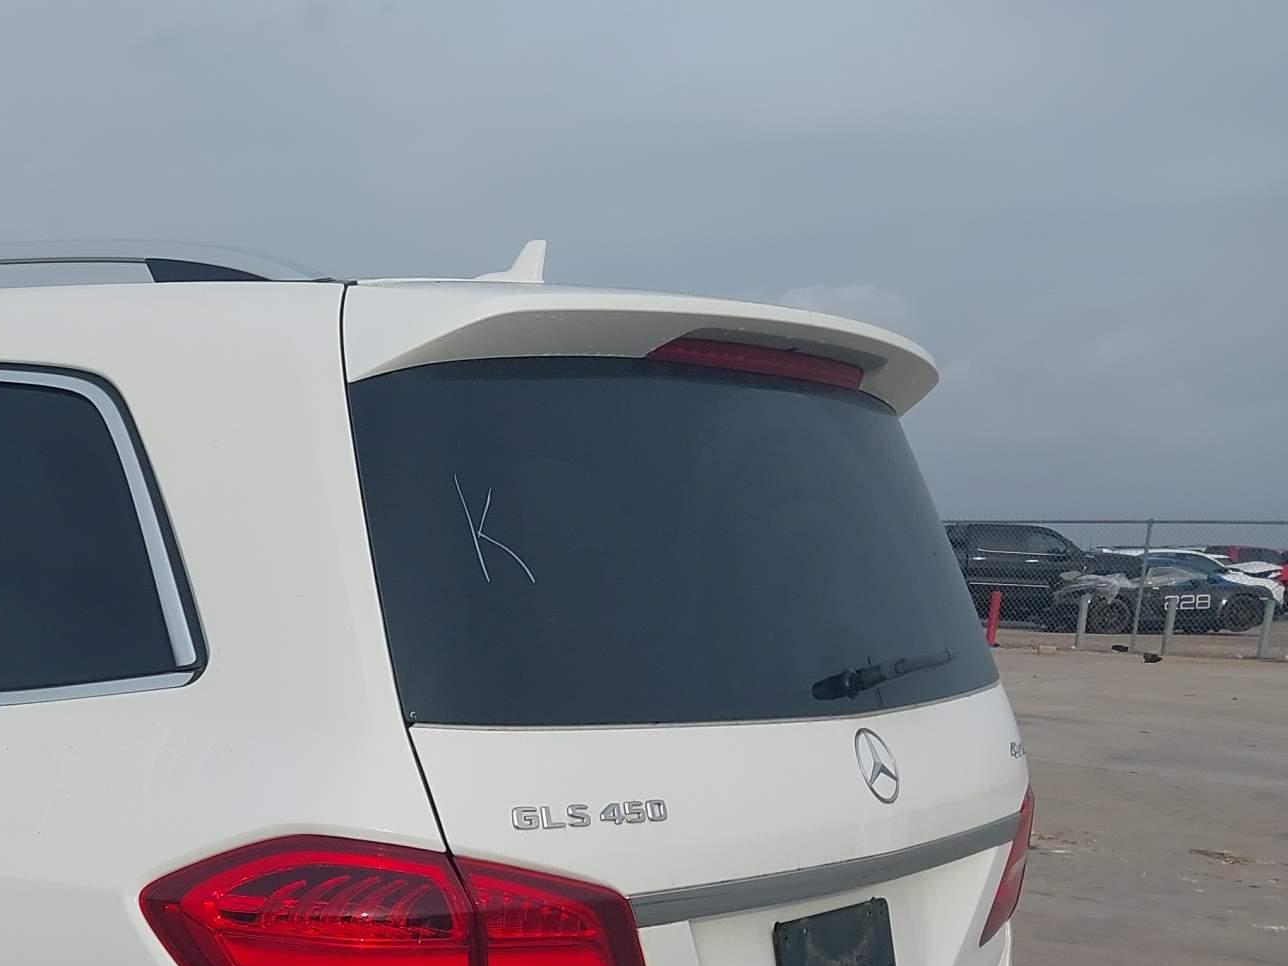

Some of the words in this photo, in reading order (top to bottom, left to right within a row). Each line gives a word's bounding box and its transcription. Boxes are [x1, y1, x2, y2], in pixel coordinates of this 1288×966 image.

[453, 473, 536, 583] K
[512, 803, 592, 831] GLS
[599, 799, 668, 826] 450
